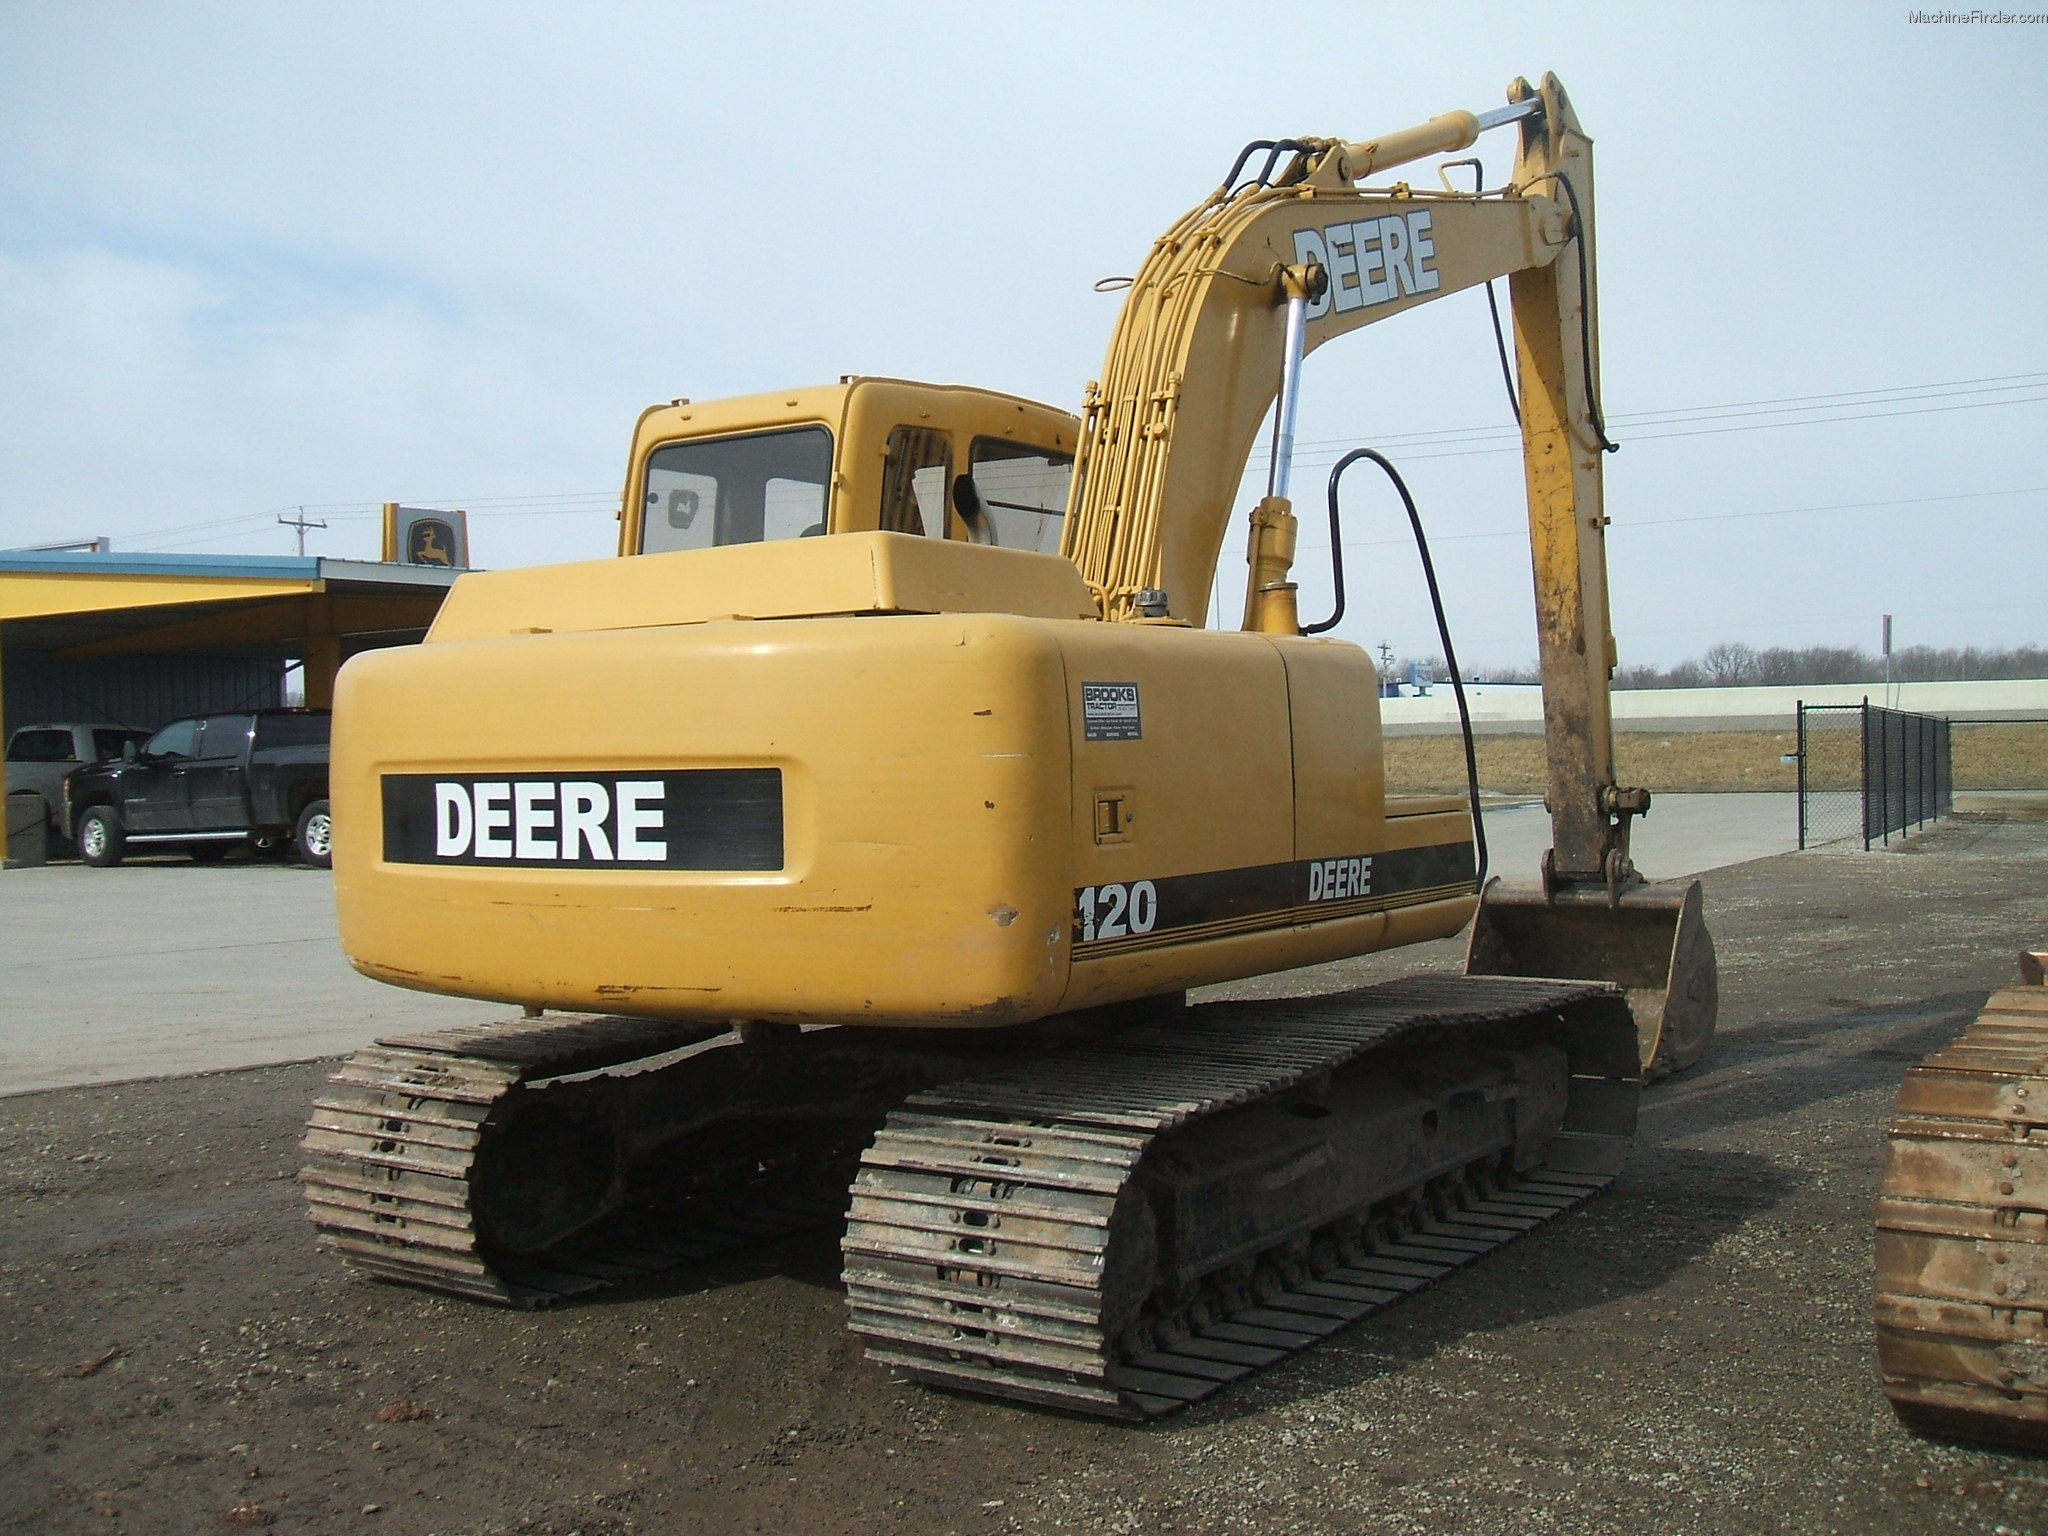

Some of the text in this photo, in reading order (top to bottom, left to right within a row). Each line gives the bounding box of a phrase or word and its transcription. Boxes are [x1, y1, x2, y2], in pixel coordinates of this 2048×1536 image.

[1293, 208, 1440, 322] DEERE
[1085, 687, 1135, 702] BROOKS
[1086, 702, 1117, 710] TRACTOR
[435, 780, 668, 861] DEERE
[1308, 857, 1372, 901] DEERE
[1078, 880, 1158, 942] 120
